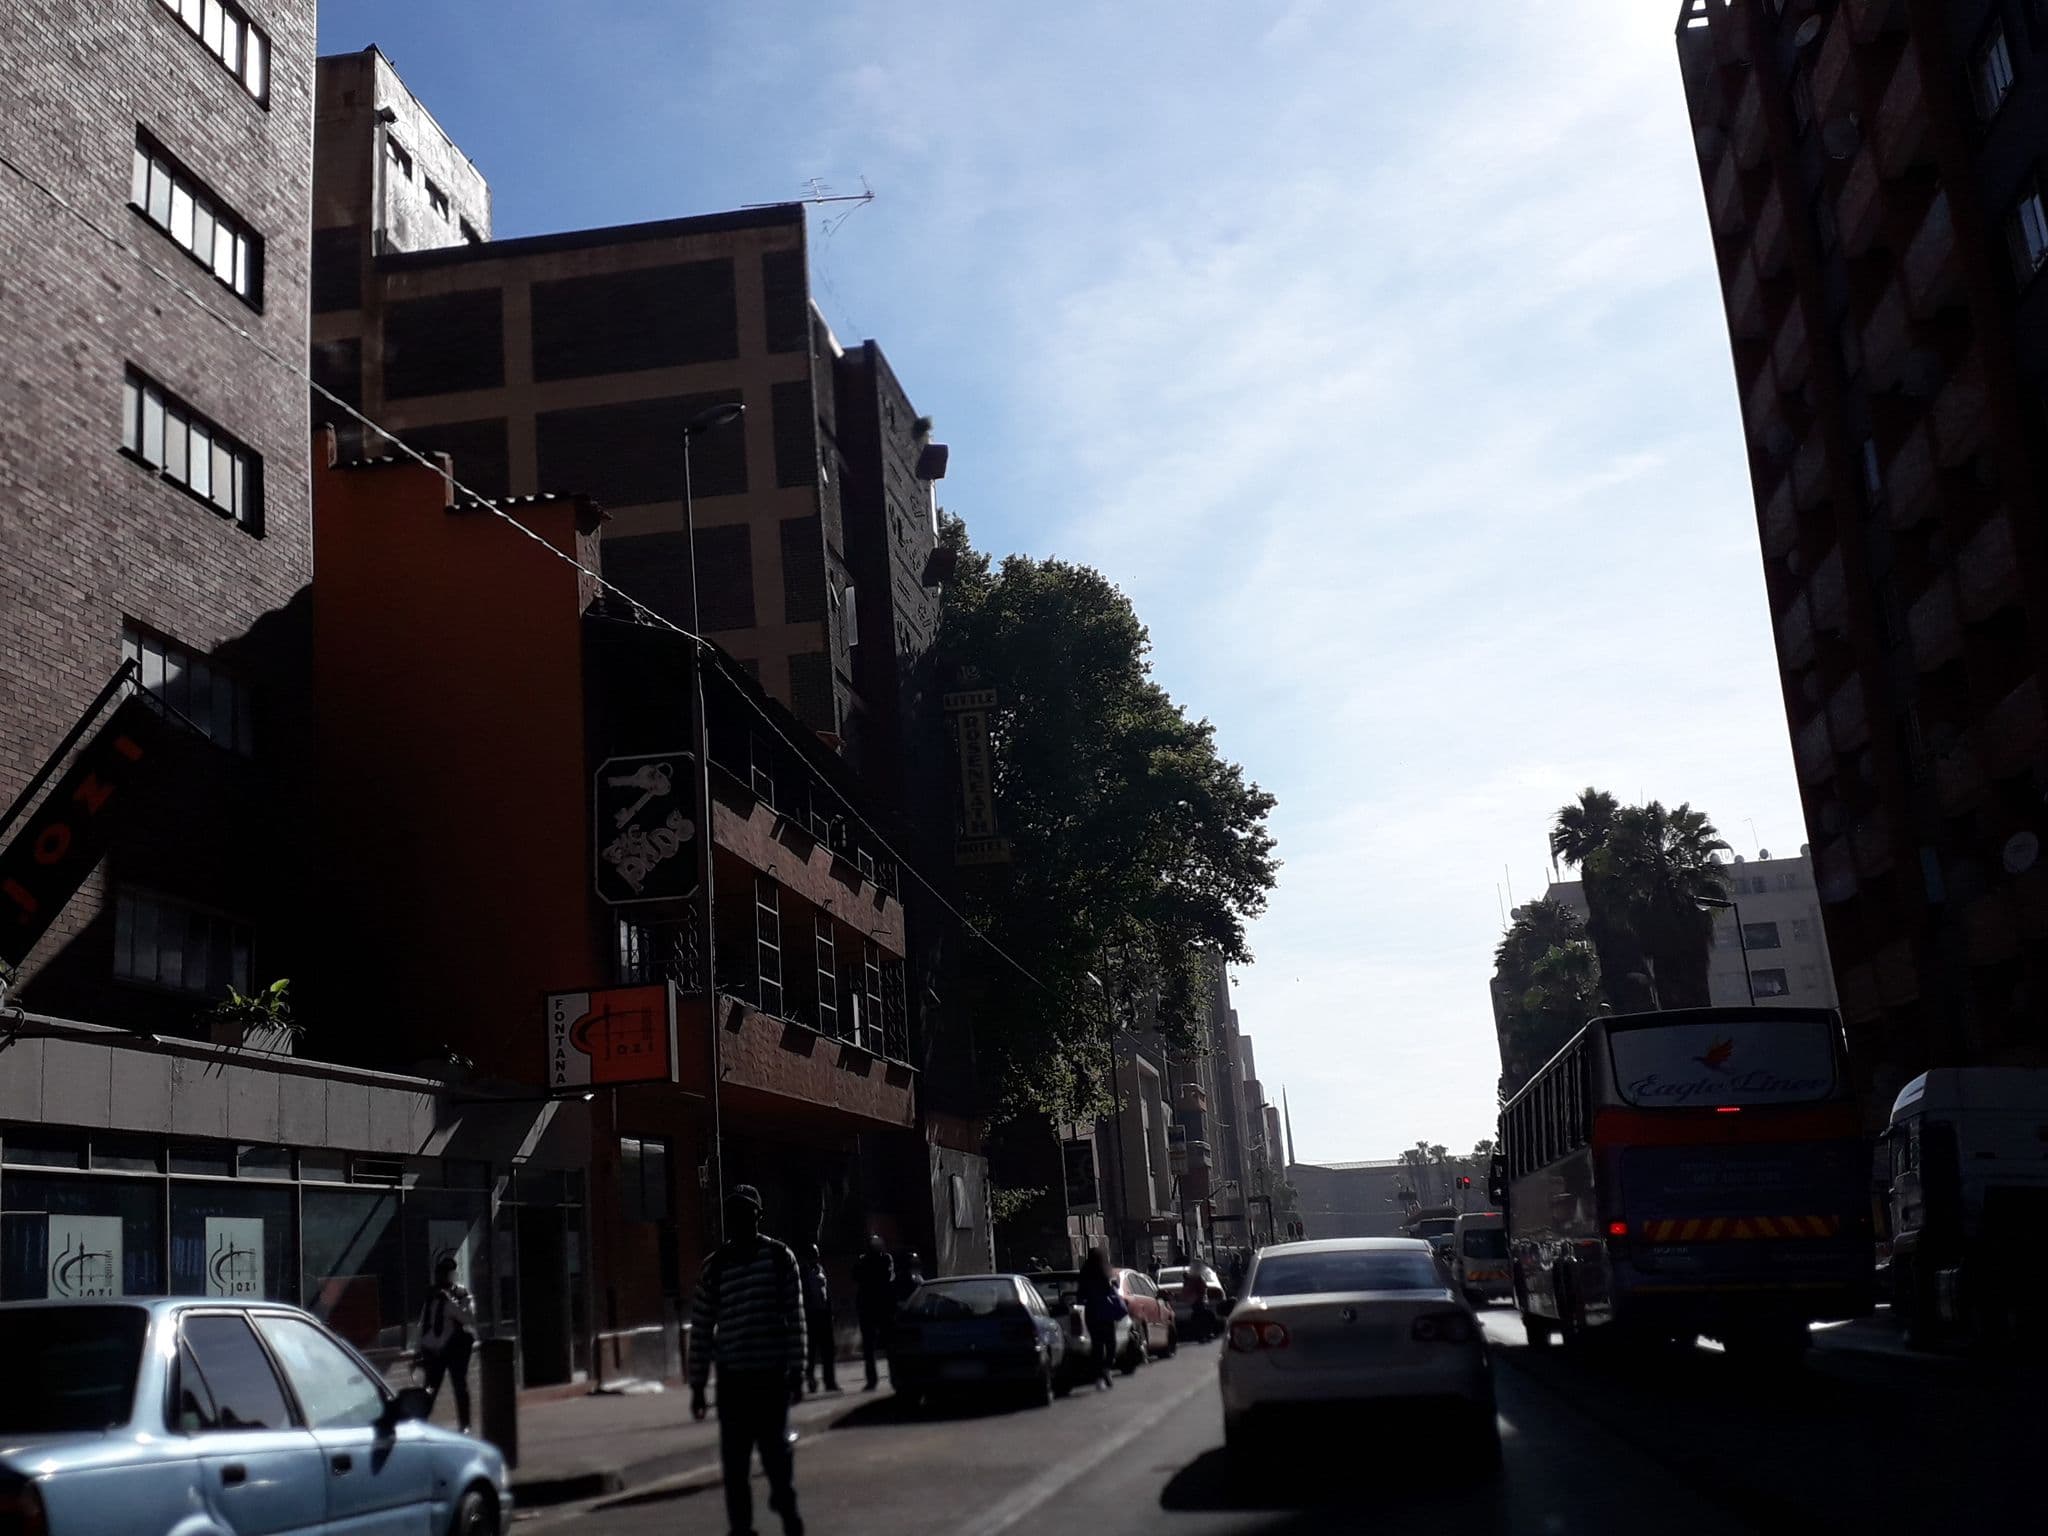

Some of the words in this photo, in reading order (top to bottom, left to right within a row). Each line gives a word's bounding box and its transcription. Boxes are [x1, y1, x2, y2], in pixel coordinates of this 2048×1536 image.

[964, 716, 987, 832] ROSENEATH
[554, 999, 567, 1084] FONTANA
[1631, 1073, 1727, 1101] Eagle
